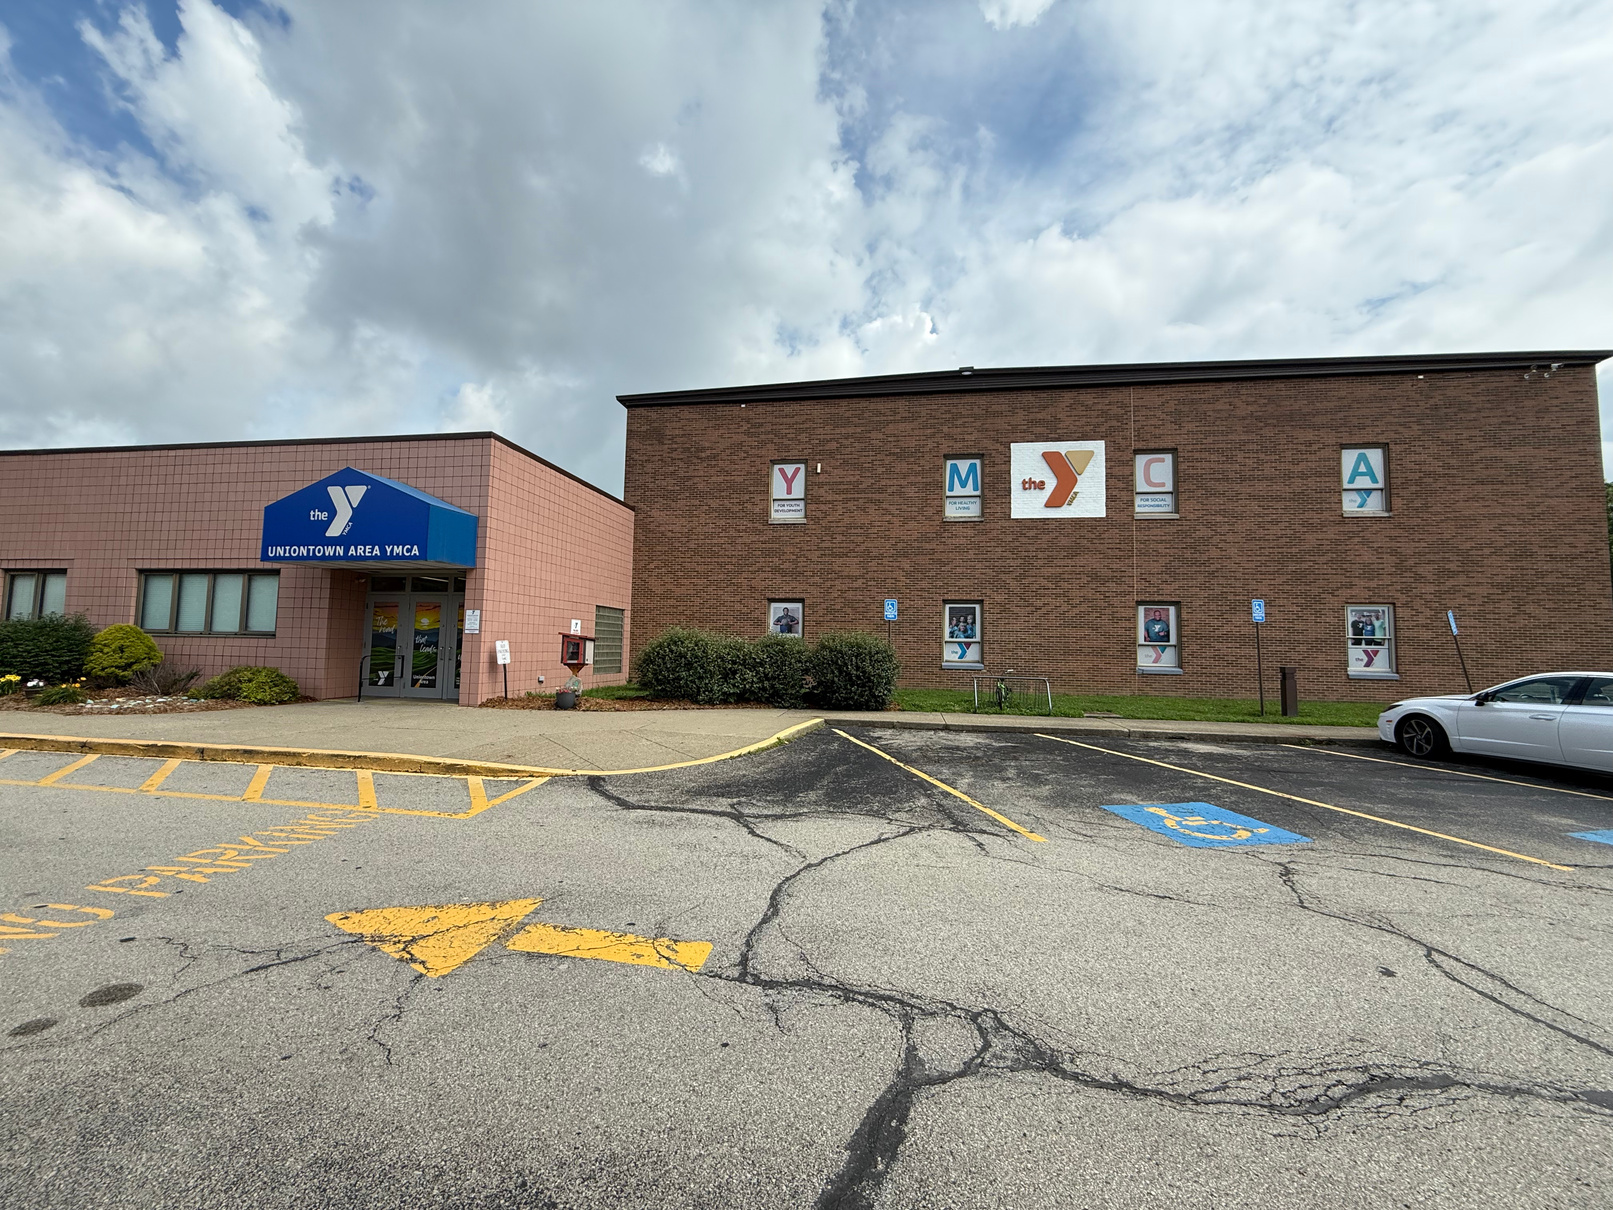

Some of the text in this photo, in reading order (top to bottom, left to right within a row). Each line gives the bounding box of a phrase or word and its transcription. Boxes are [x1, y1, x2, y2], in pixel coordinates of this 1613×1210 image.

[777, 466, 801, 496] Y
[947, 462, 979, 492] M
[1021, 450, 1095, 508] the Y
[1143, 457, 1166, 488] C
[1346, 452, 1380, 485] A
[310, 485, 367, 537] the Y
[1066, 491, 1080, 507] YMCA
[341, 521, 354, 536] YMCA
[268, 544, 420, 557] UNIONTOWN AREA YMCA
[84, 810, 381, 898] PARKING
